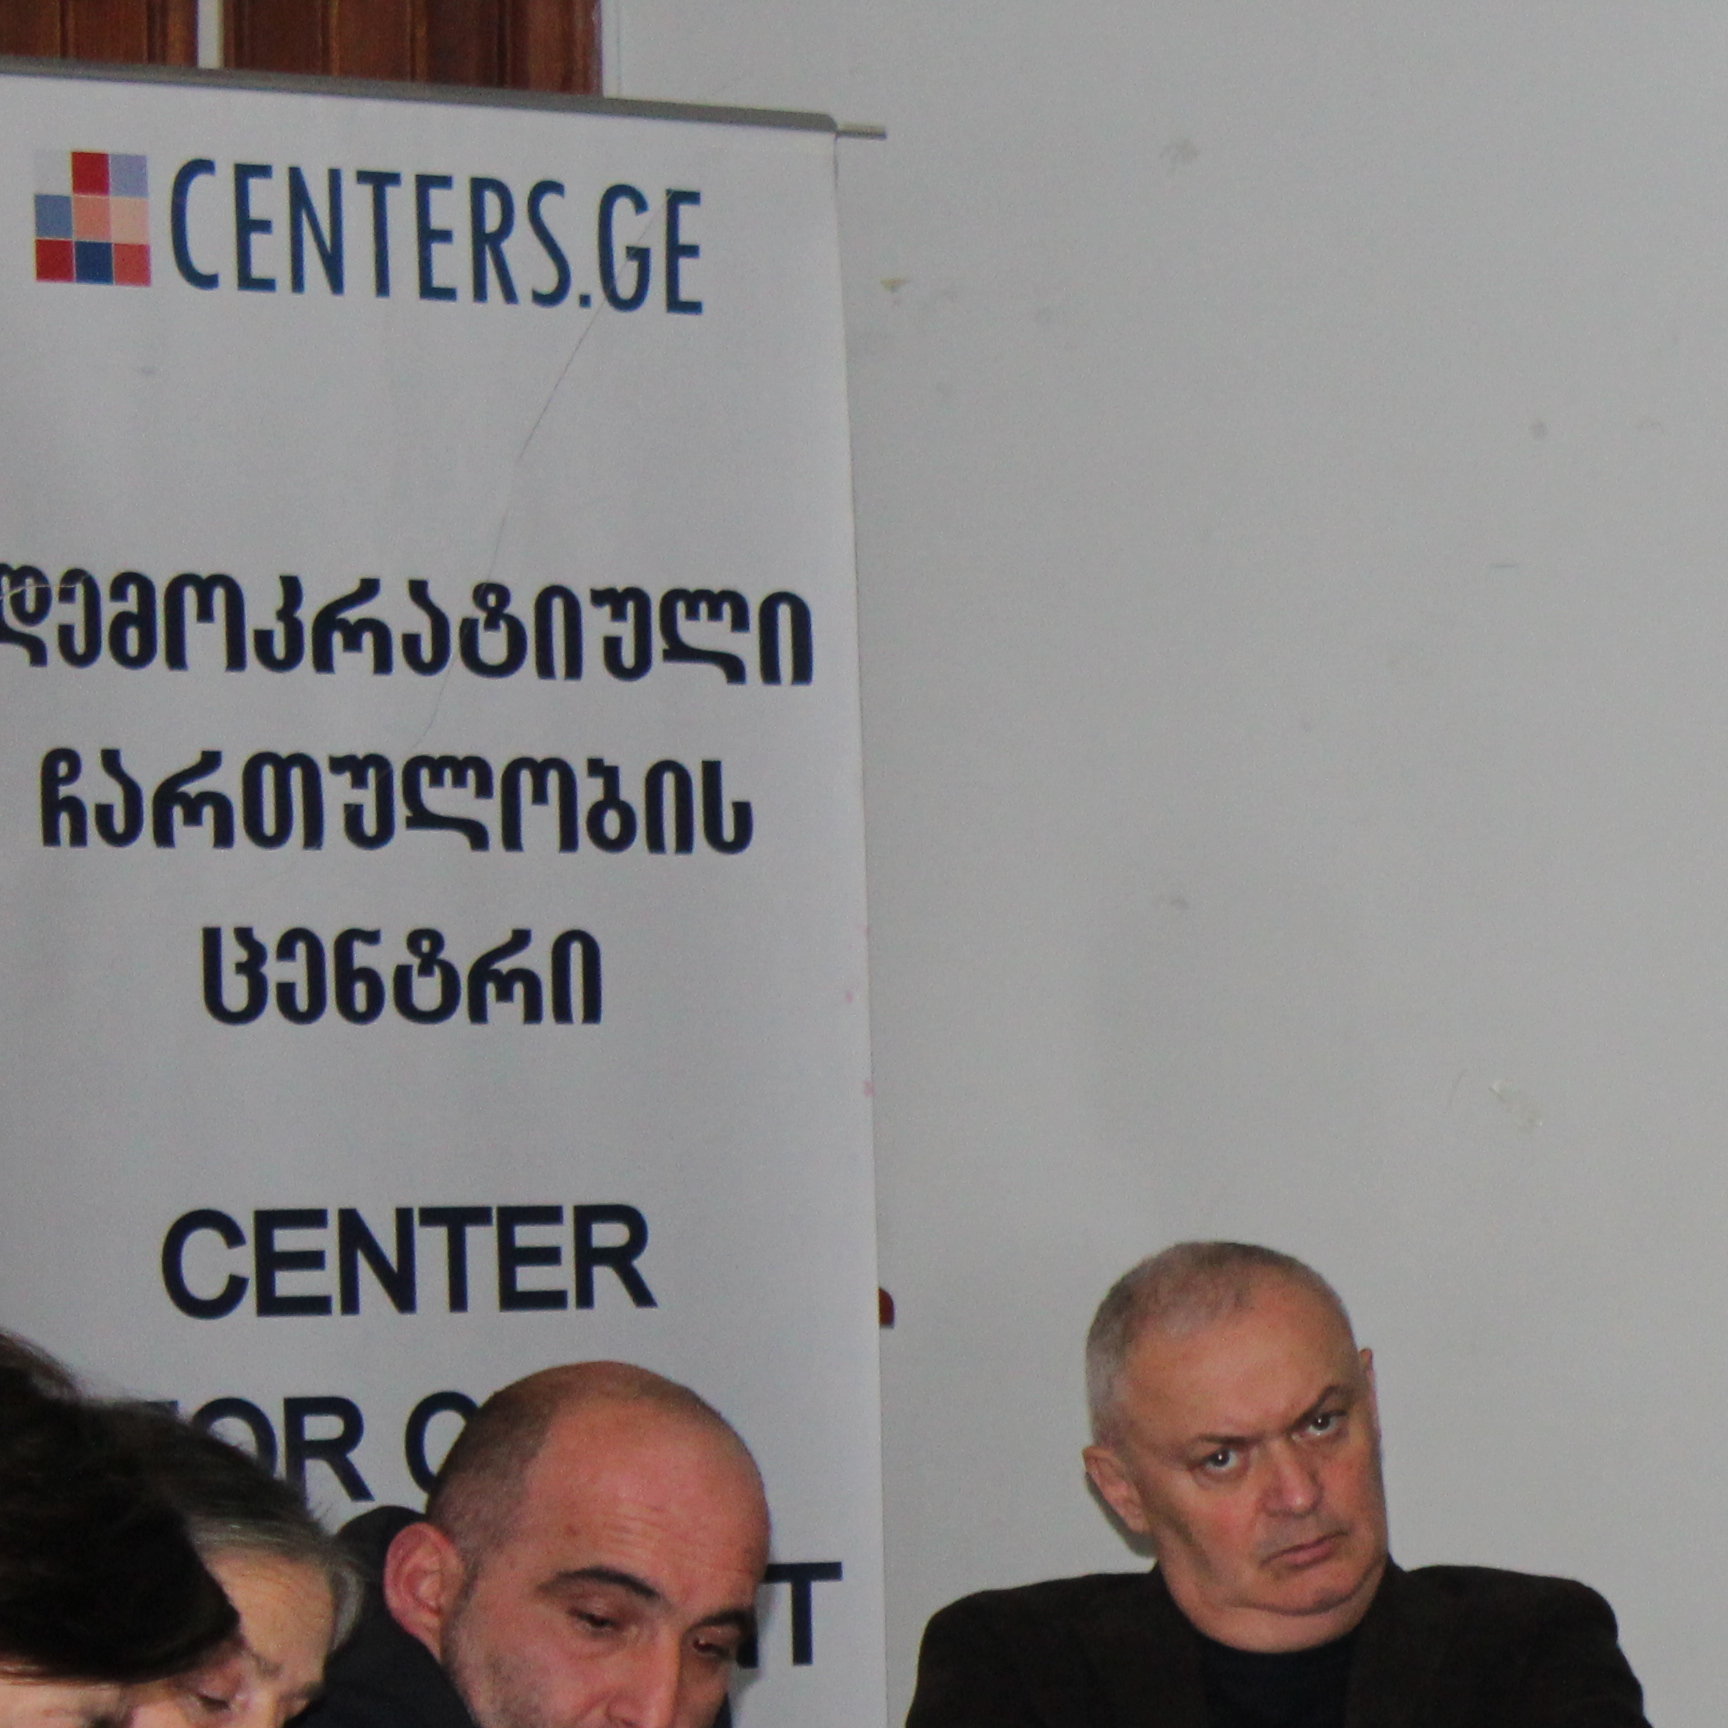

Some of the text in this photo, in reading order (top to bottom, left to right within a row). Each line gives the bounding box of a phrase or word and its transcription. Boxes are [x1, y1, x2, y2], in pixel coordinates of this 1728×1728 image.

[170, 158, 703, 313] CENTERS.GE
[0, 562, 813, 685] დემოკრატიული
[39, 747, 754, 854] ჩართულობის
[202, 926, 603, 1025] ცენტრი
[161, 1203, 657, 1320] CENTER
[165, 1396, 374, 1501] OR
